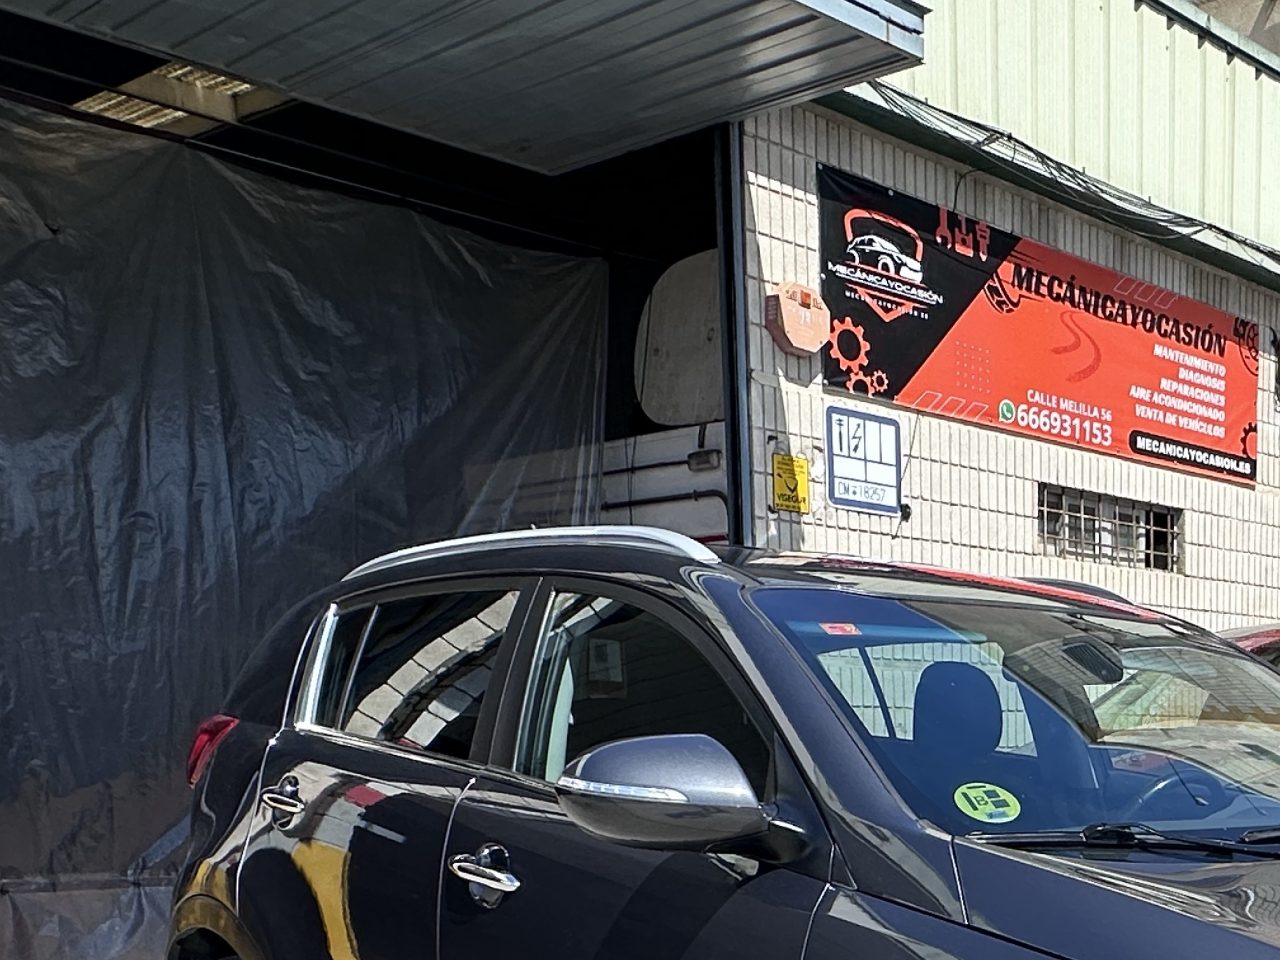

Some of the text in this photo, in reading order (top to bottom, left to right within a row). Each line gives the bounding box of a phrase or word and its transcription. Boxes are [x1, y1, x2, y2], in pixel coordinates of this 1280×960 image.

[828, 261, 944, 304] MECÁNICAYOCASIÓN
[1011, 262, 1227, 357] MECÁNICAYOCASIÓN
[1153, 343, 1226, 377] MANTENIMIENTO
[1160, 378, 1226, 407] REPARACIONES
[1179, 367, 1226, 392] DIAGNOSIS
[1027, 389, 1112, 421] CALLE MELILLA 56
[1129, 385, 1225, 422] AIRE ACONDICIONADO
[1135, 403, 1225, 438] VENTA DE VEHÍCULOS
[1017, 403, 1112, 446] 666931153
[1136, 436, 1251, 474] MECANICAYOCASION.ES
